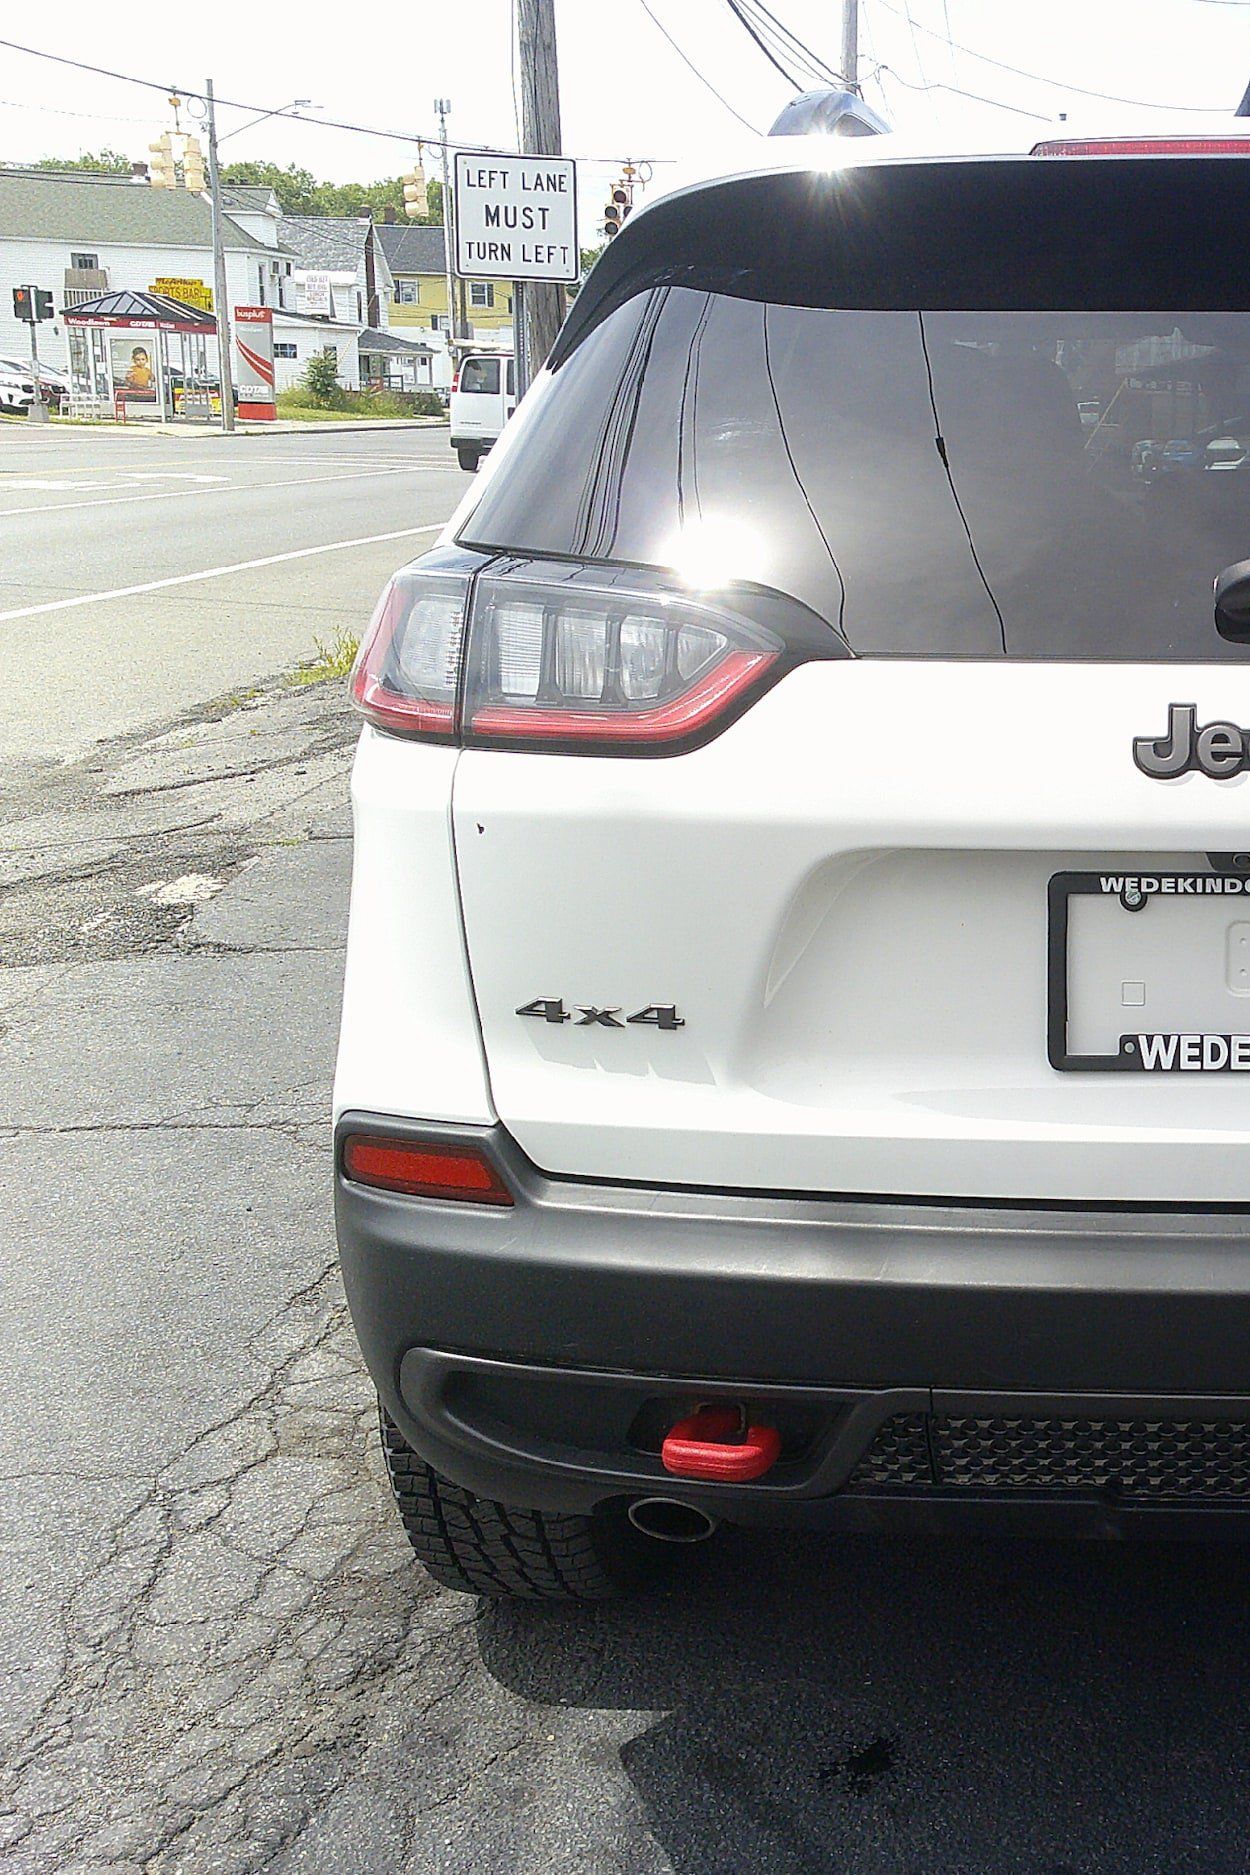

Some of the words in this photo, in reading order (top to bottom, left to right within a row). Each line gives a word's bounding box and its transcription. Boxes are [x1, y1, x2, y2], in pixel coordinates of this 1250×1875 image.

[466, 168, 509, 189] LEFT
[522, 172, 567, 193] LANE
[484, 204, 550, 230] MUST
[466, 241, 511, 262] TURN
[522, 244, 569, 265] LEFT
[514, 995, 686, 1031] 4x4
